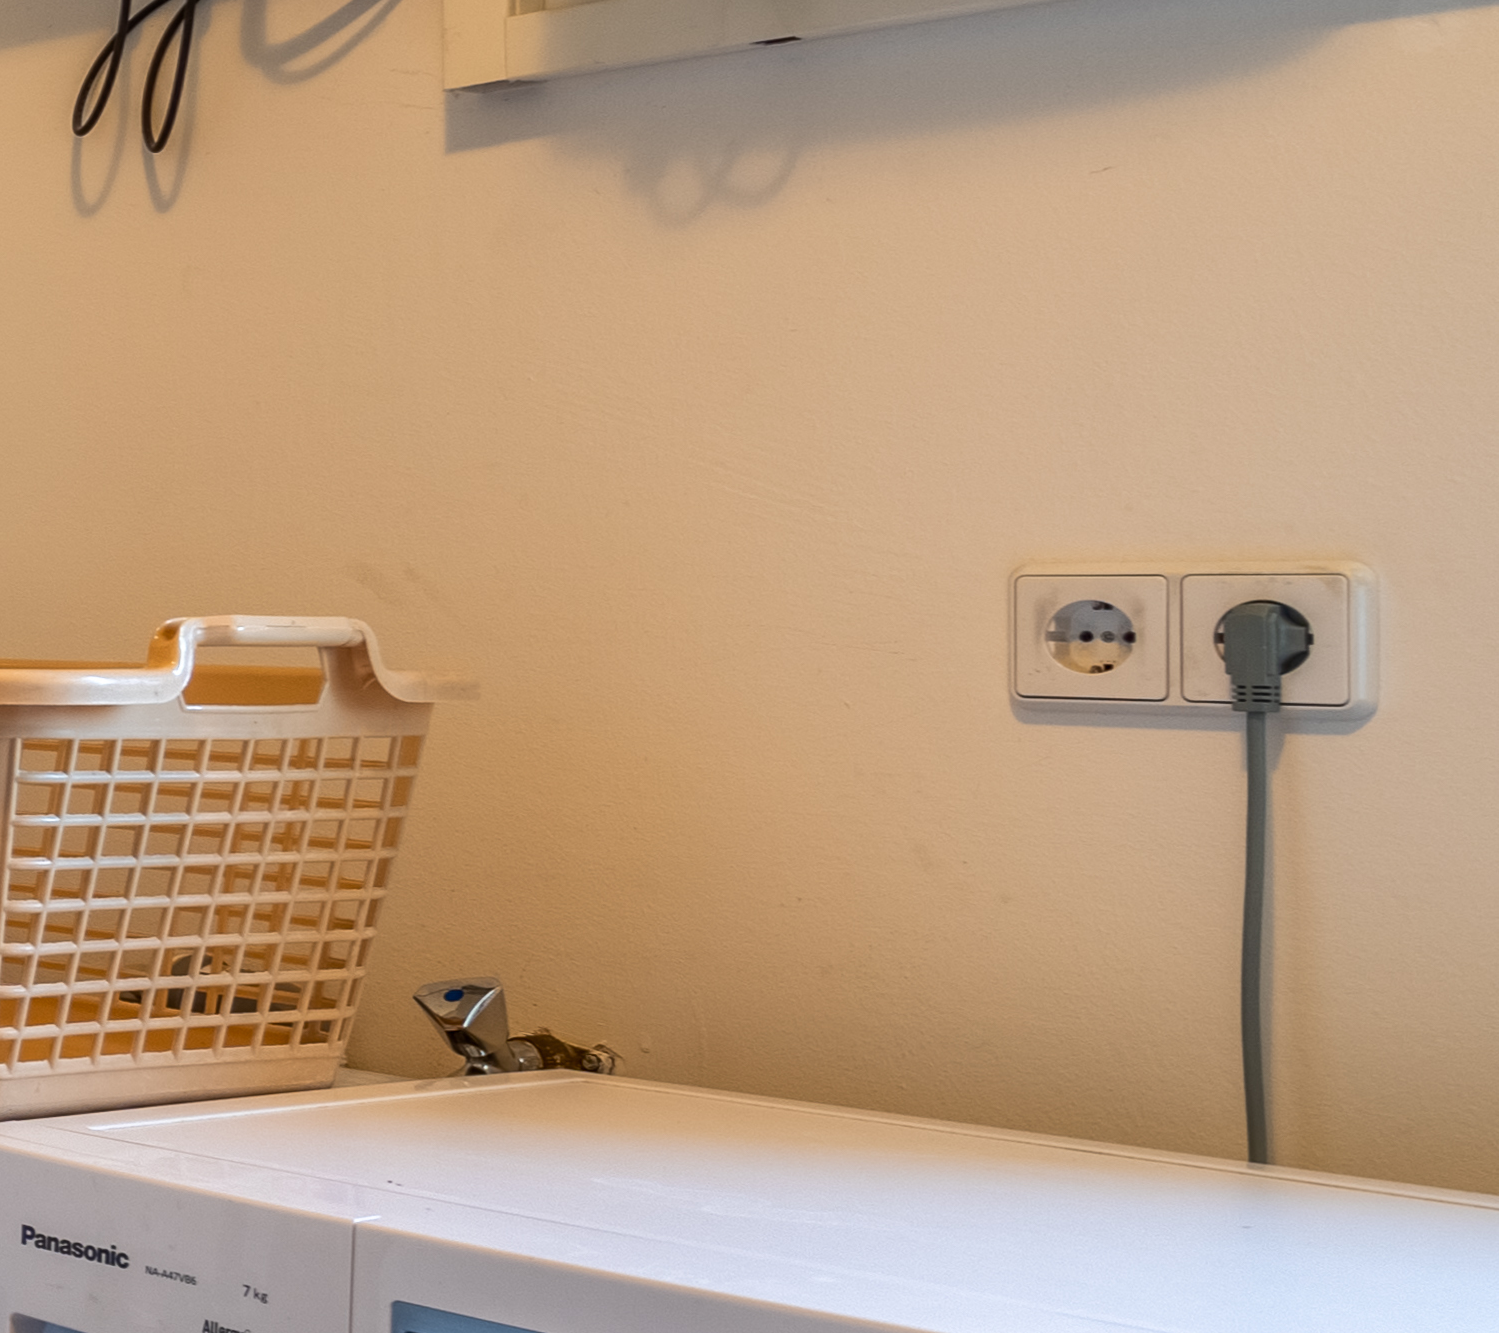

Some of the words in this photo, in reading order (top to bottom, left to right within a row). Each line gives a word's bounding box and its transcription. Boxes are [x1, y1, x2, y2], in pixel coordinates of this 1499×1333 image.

[21, 1224, 130, 1269] Panasonic
[242, 1284, 251, 1298] 7
[253, 1288, 269, 1304] kg
